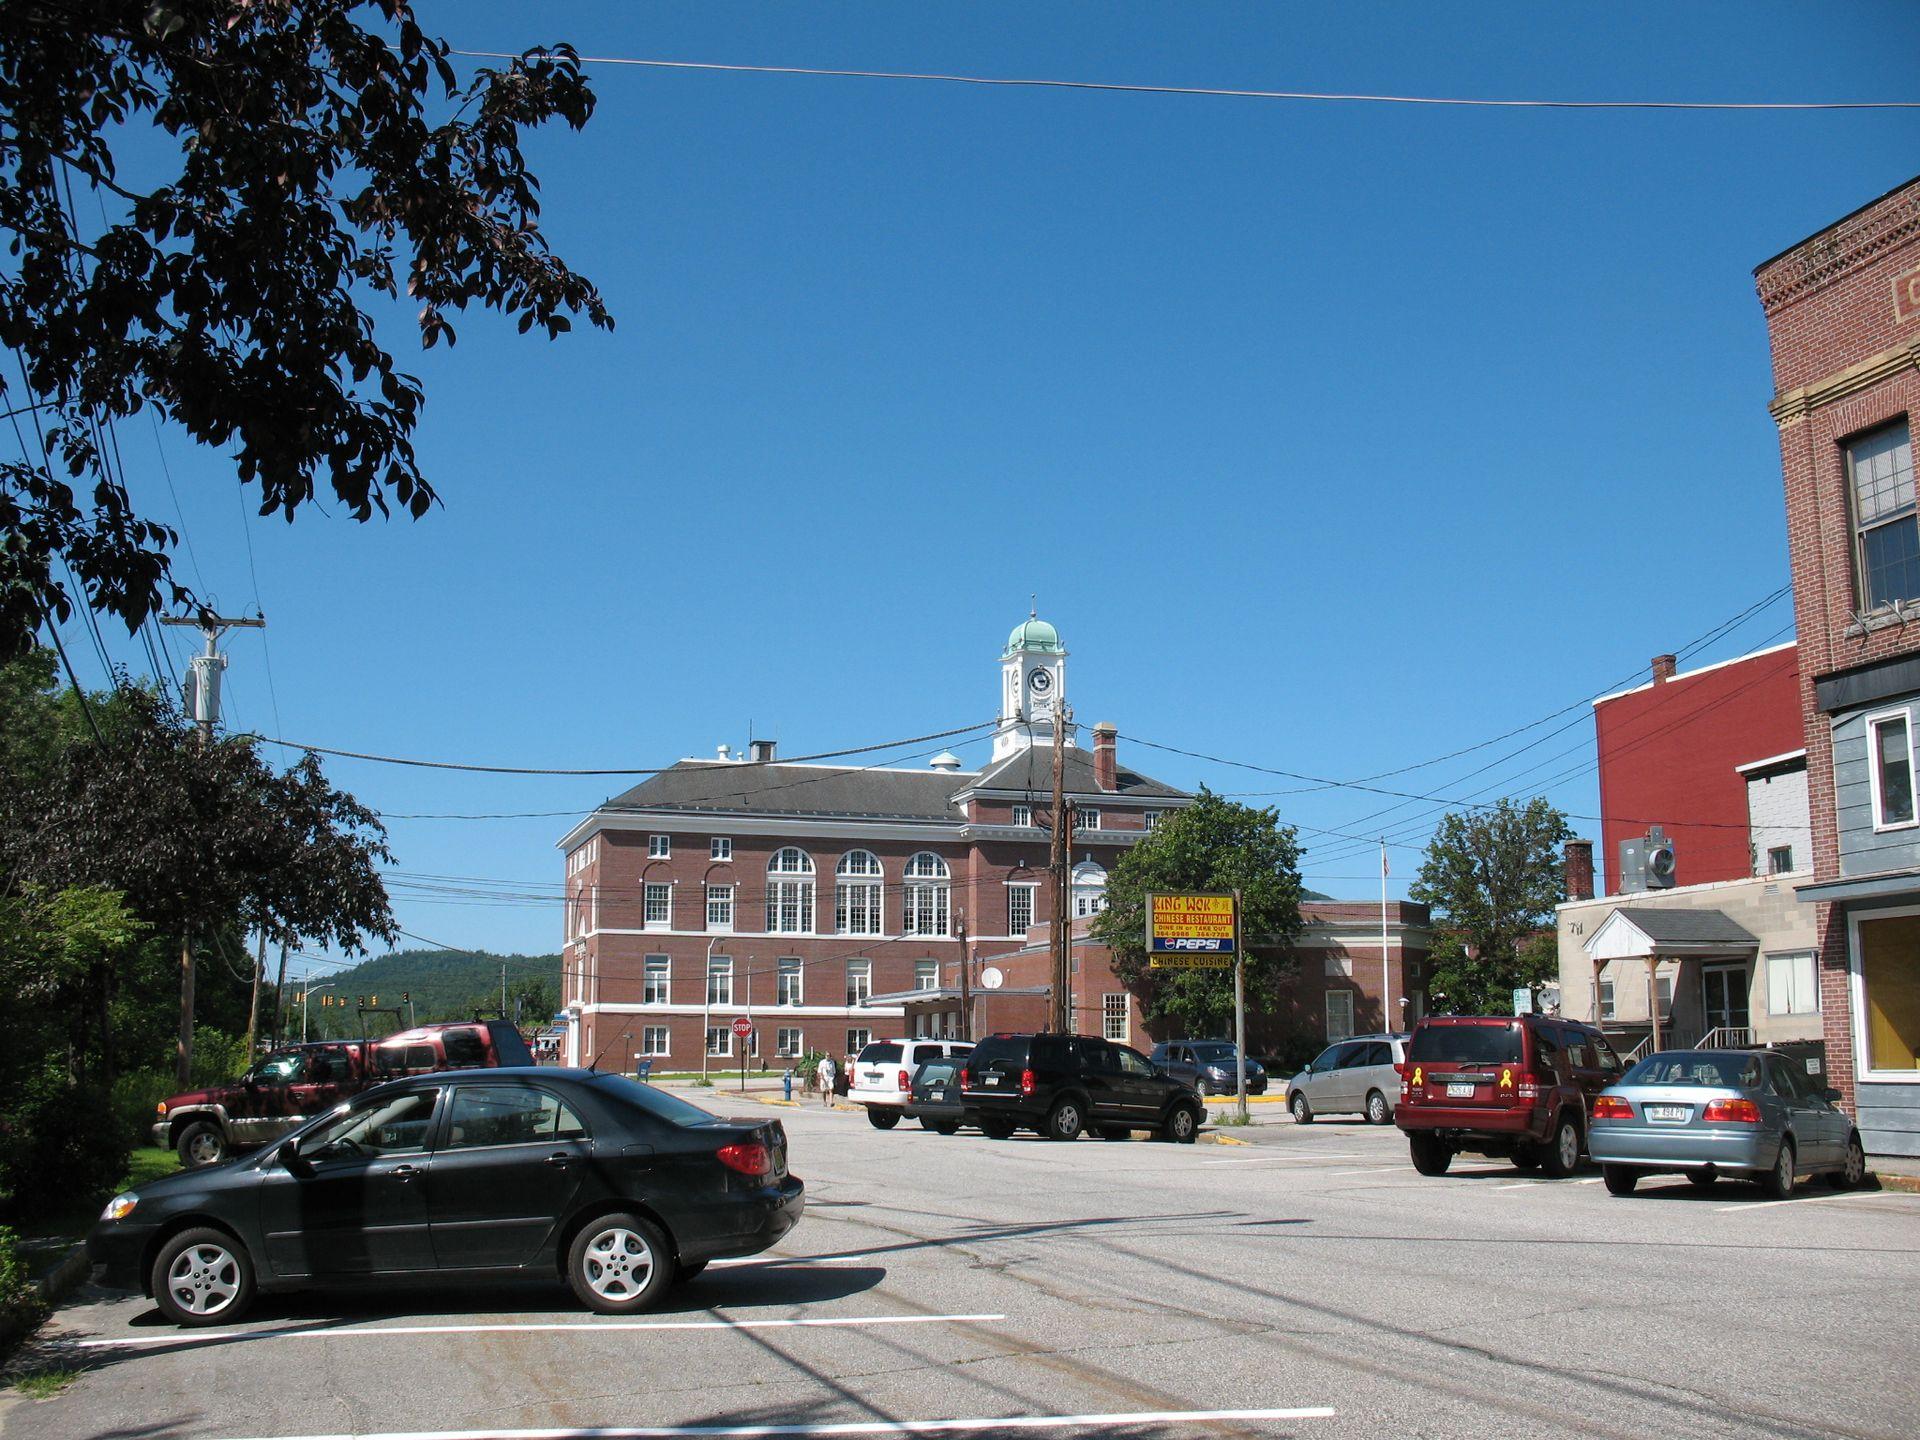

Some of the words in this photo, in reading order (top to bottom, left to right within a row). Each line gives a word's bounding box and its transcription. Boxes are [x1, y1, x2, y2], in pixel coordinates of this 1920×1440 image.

[1153, 896, 1181, 910] KING
[1186, 897, 1211, 911] WOK
[1154, 914, 1184, 923] CHINESE
[1186, 914, 1231, 924] RESTAURANT
[1175, 939, 1220, 949] PEPSI
[1152, 956, 1190, 966] CHINESE
[1193, 956, 1229, 966] CUISINE
[733, 1023, 751, 1032] STOP
